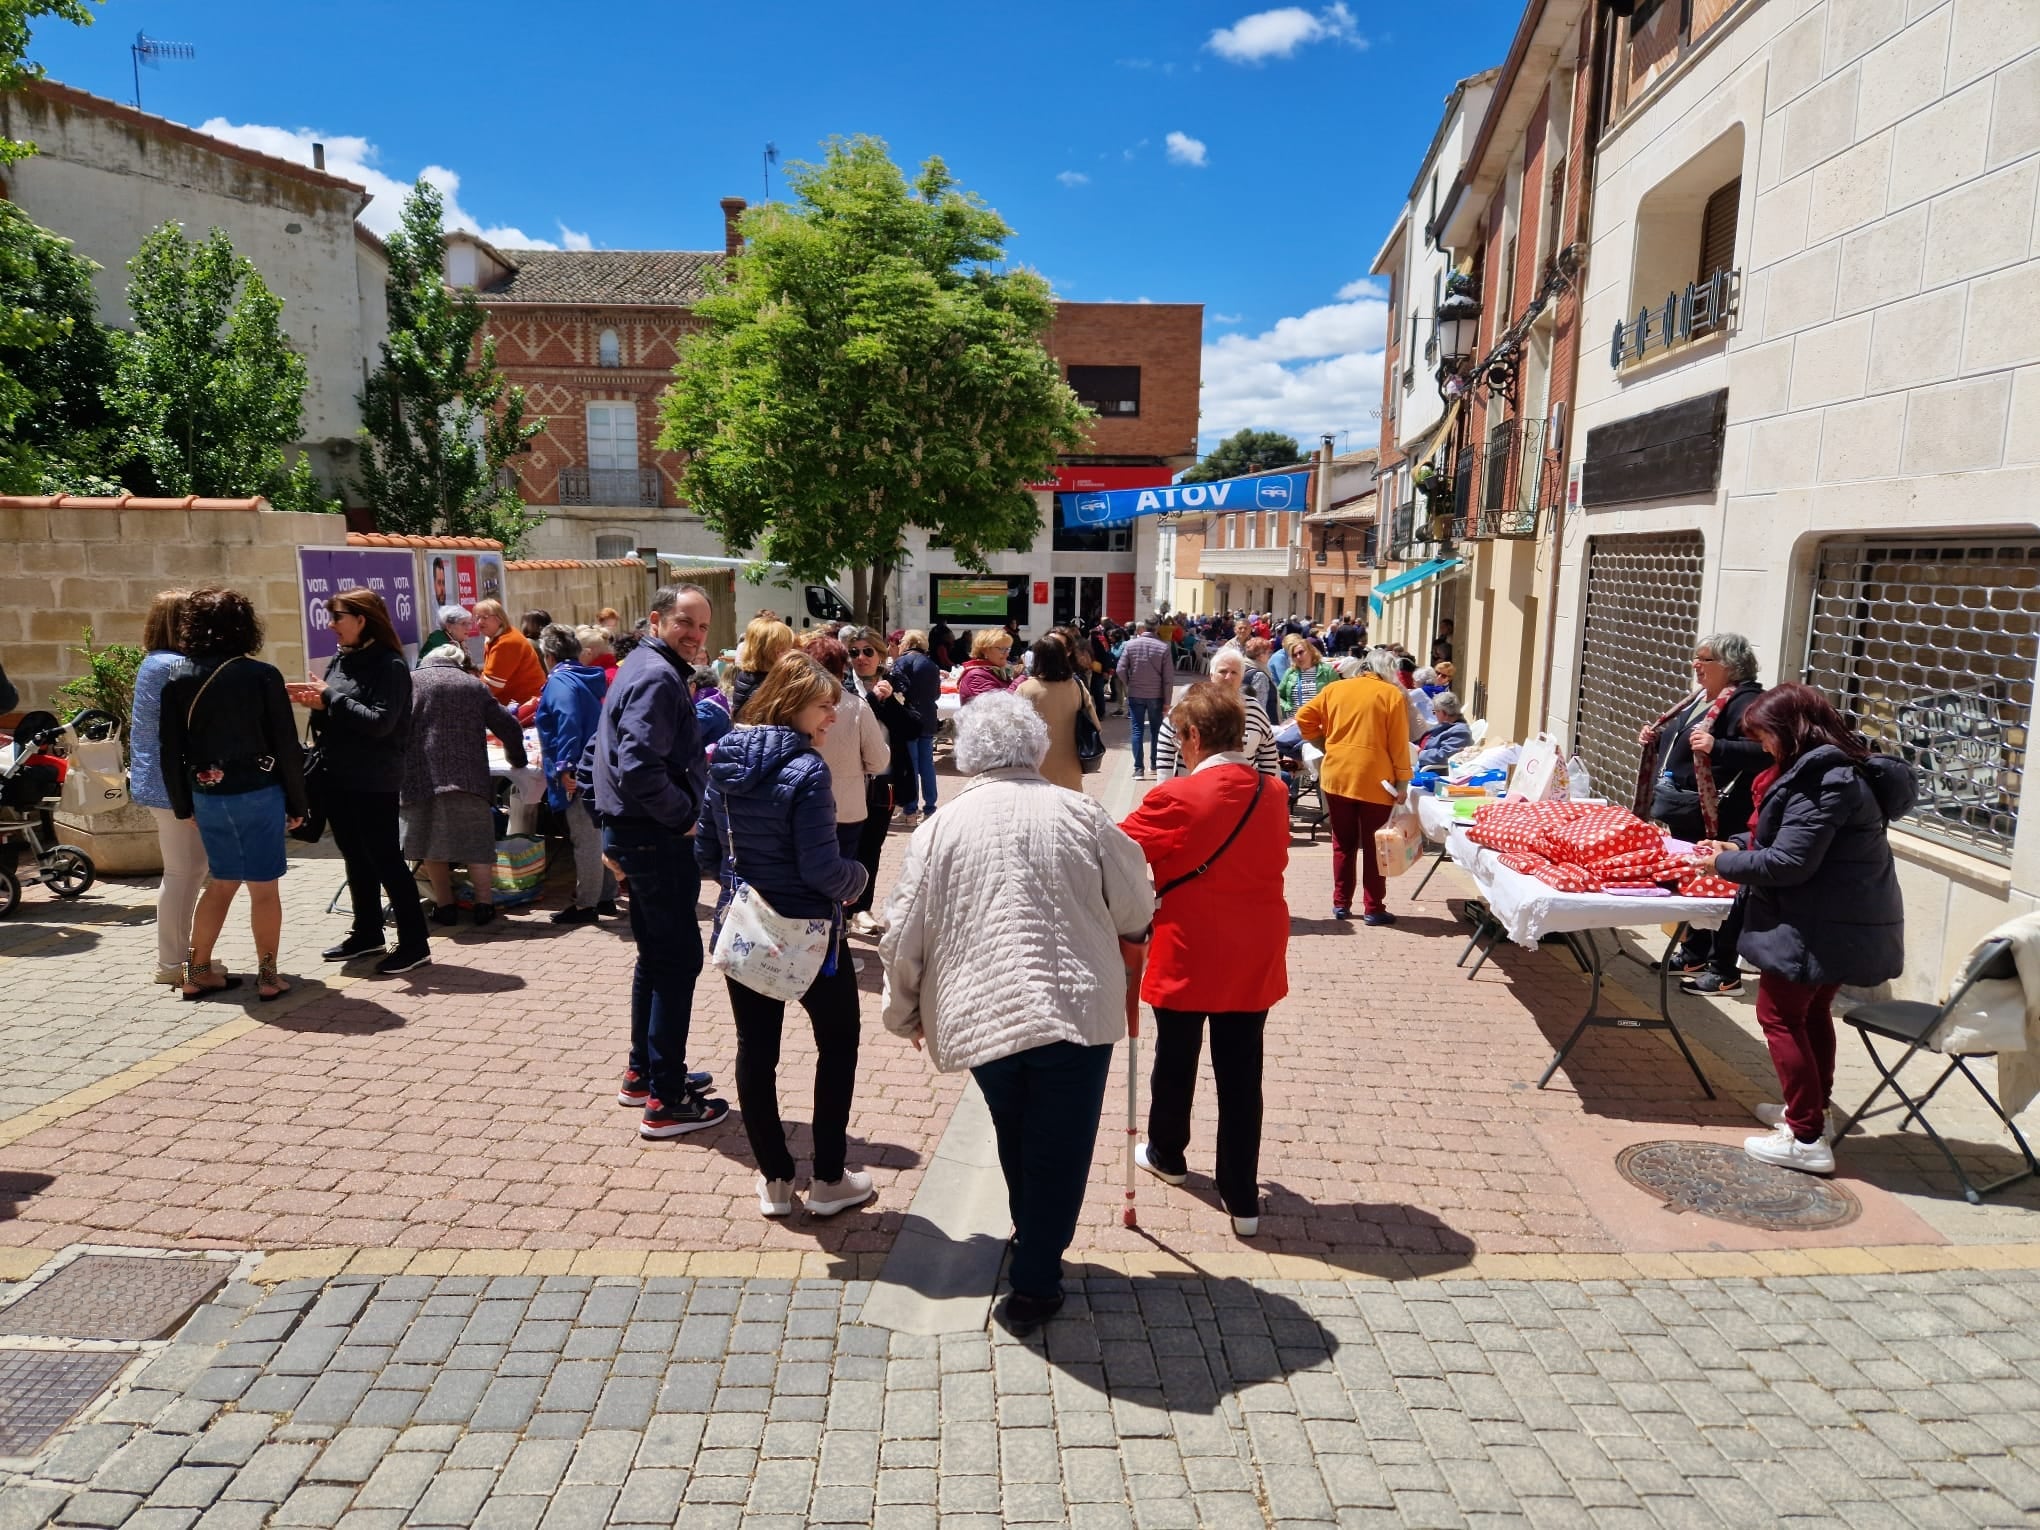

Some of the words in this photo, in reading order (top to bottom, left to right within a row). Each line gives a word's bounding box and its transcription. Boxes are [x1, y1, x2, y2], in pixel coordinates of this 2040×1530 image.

[307, 578, 328, 592] VOTA
[337, 578, 356, 591] VOTA
[366, 577, 385, 590] VOTA
[393, 576, 410, 589] VOTA
